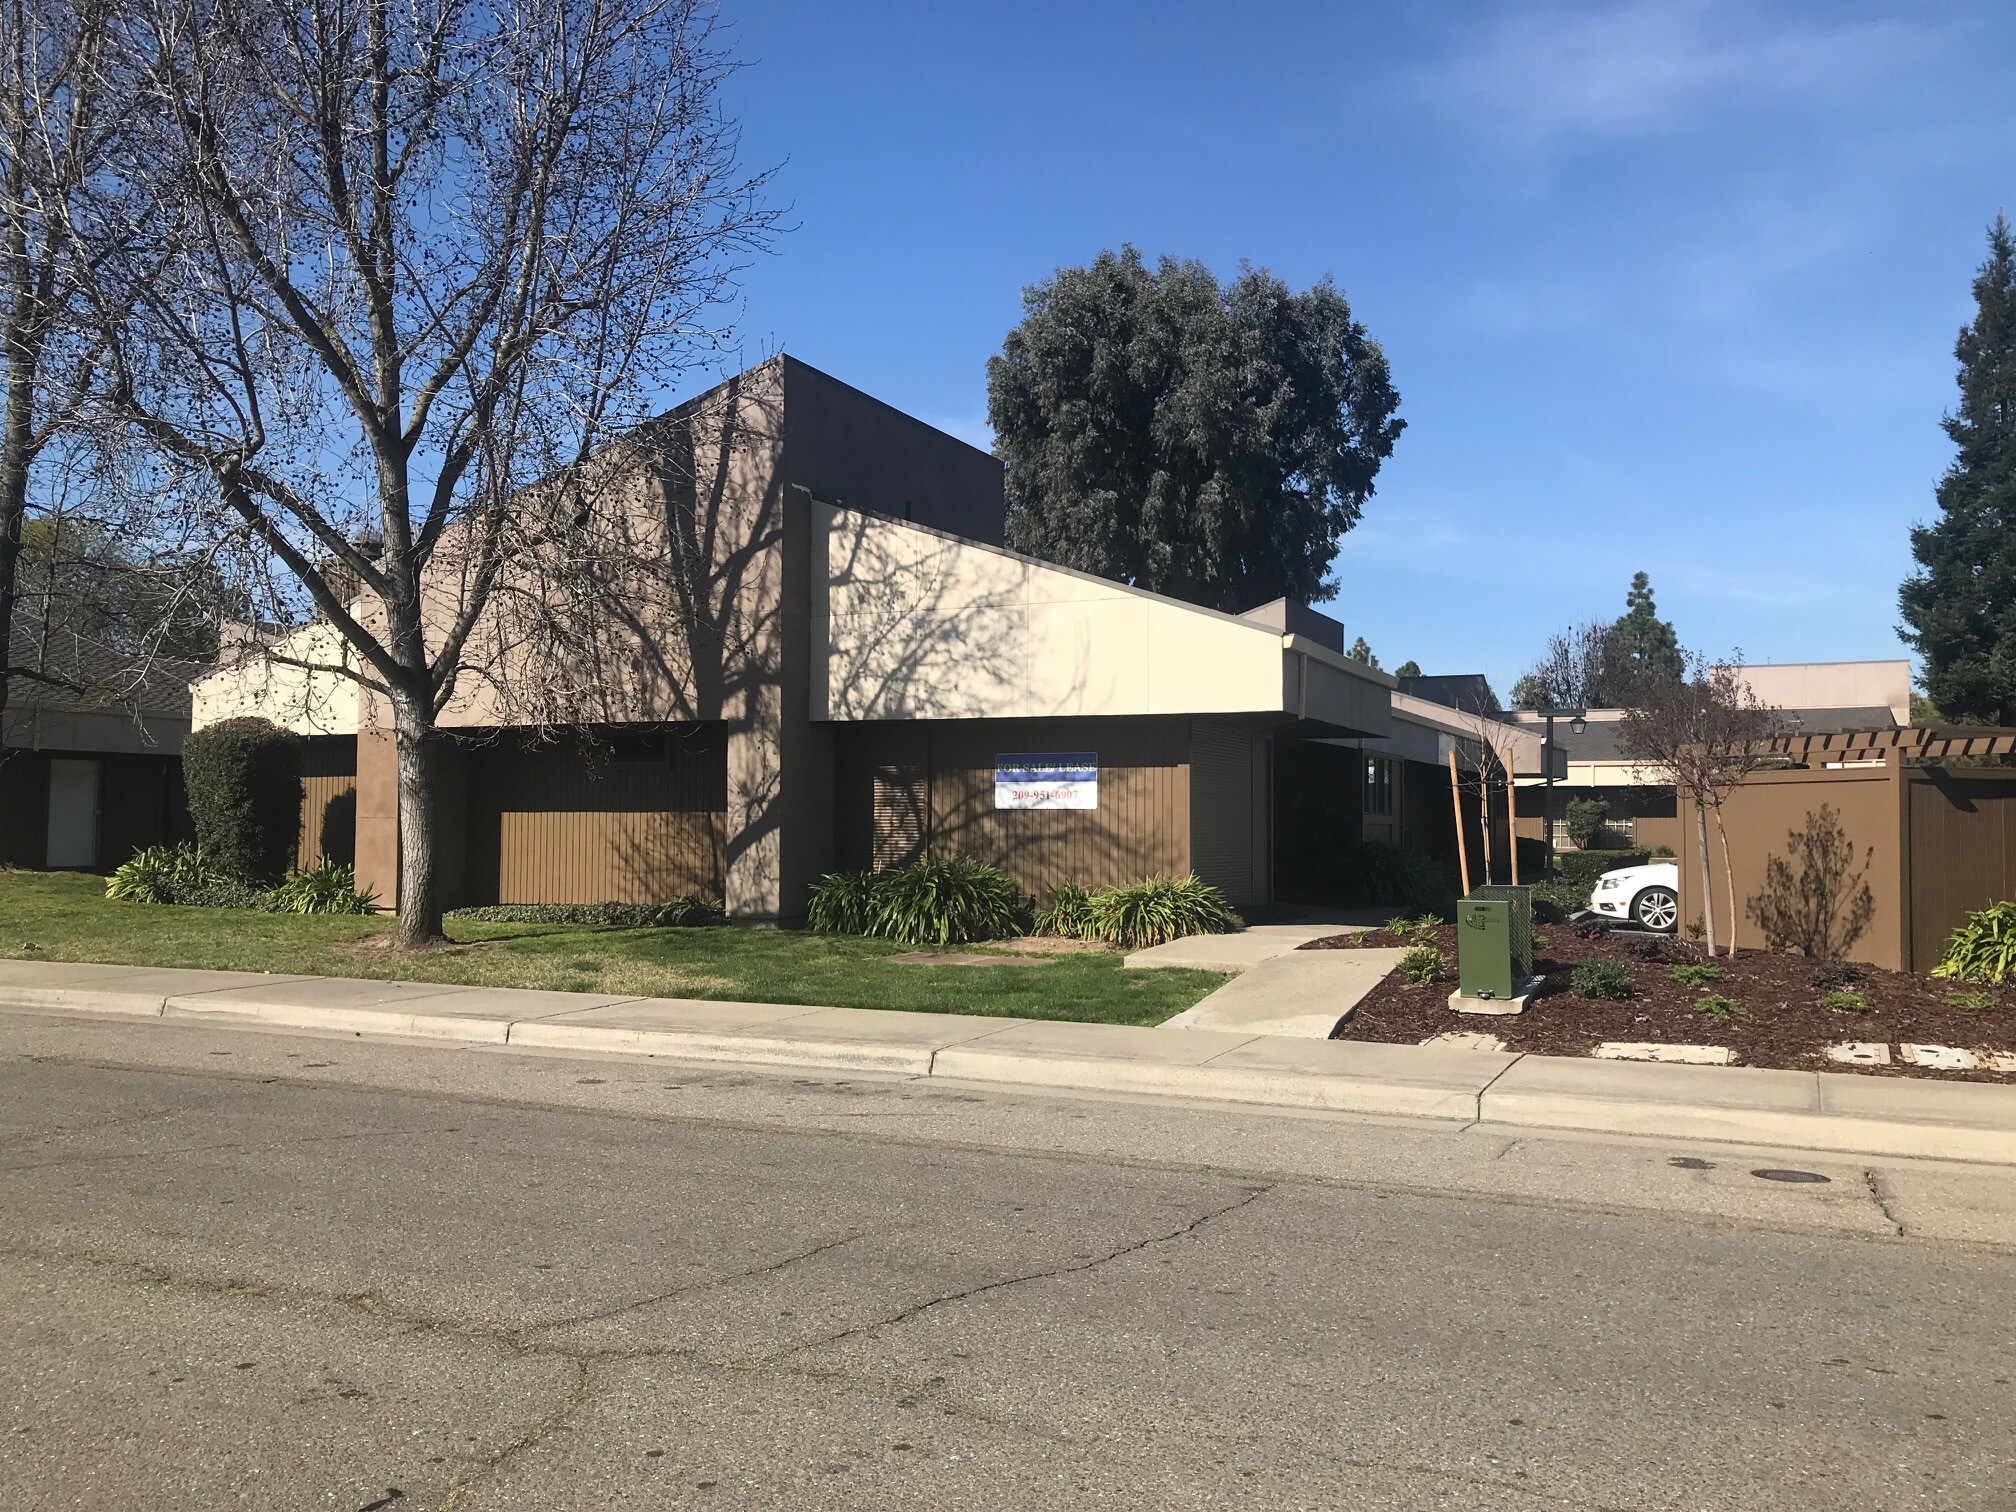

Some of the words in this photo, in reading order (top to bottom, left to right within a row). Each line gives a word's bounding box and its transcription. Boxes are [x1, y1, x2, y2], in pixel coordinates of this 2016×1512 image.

[997, 763, 1019, 773] FOR
[1058, 762, 1096, 772] LEASE
[1012, 790, 1078, 800] 209-951-6907
